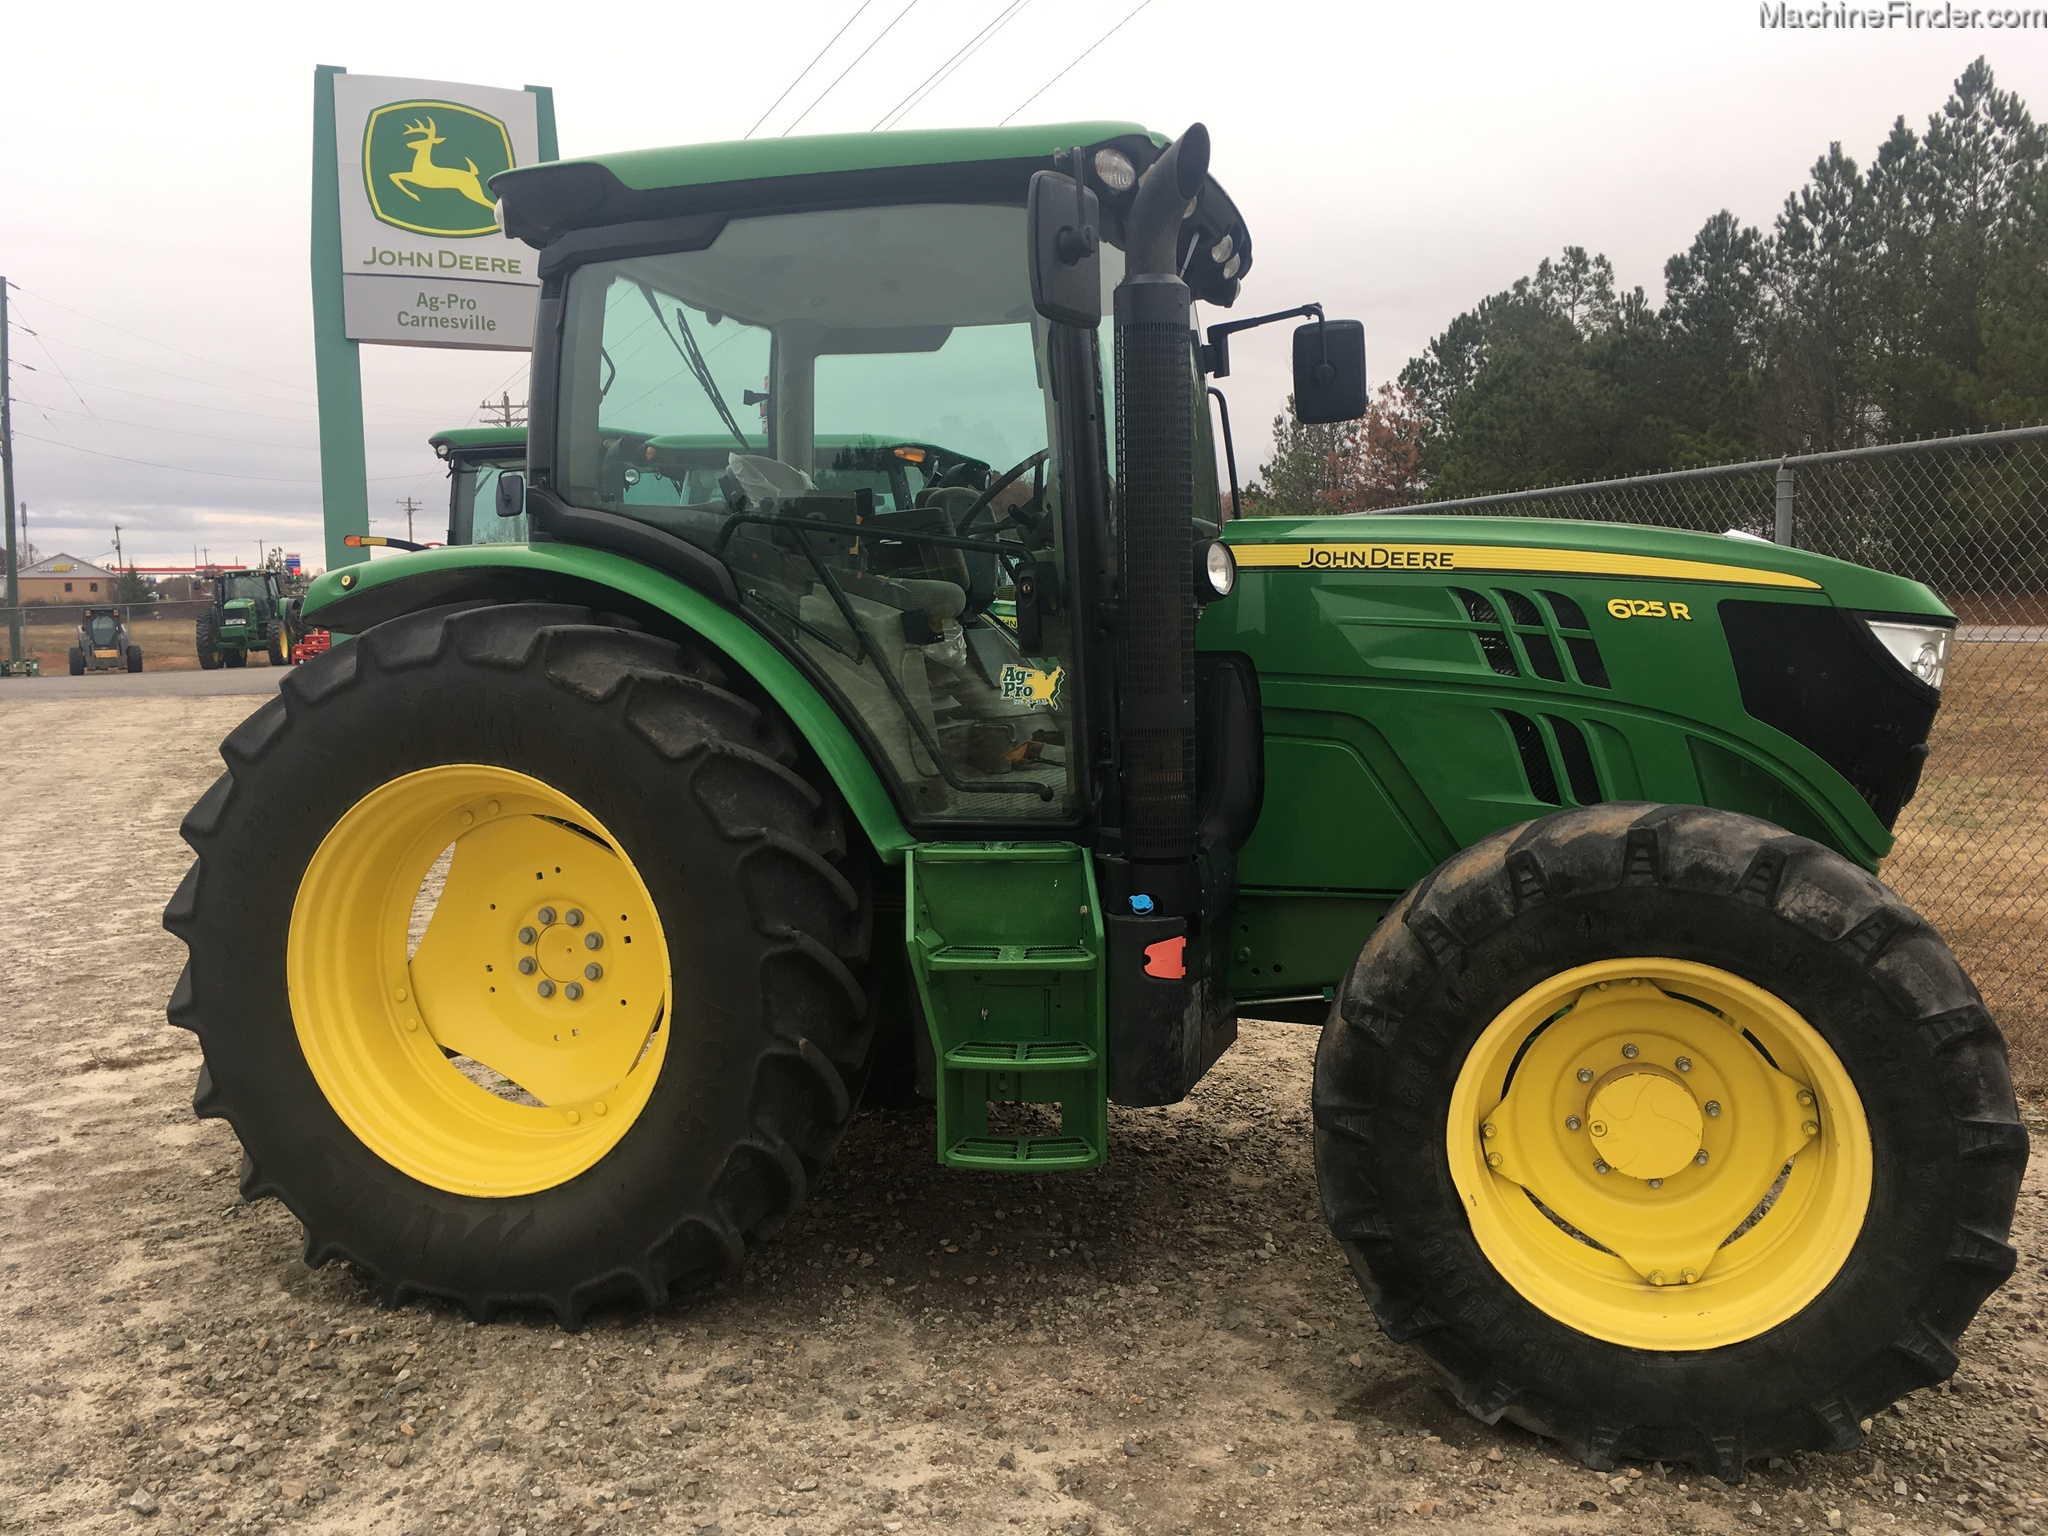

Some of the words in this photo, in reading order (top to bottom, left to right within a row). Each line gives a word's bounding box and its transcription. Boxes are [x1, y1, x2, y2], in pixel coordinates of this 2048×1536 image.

[363, 246, 433, 268] JOHN
[438, 250, 522, 275] DEERE
[416, 292, 476, 311] Ag-Pro
[397, 310, 496, 331] Carnesville
[1301, 547, 1366, 566] JOHN
[1371, 547, 1454, 567] DEERE
[1606, 598, 1668, 620] 6125
[1668, 601, 1693, 621] R
[1002, 666, 1033, 685] Ag-
[1002, 682, 1034, 698] Pro
